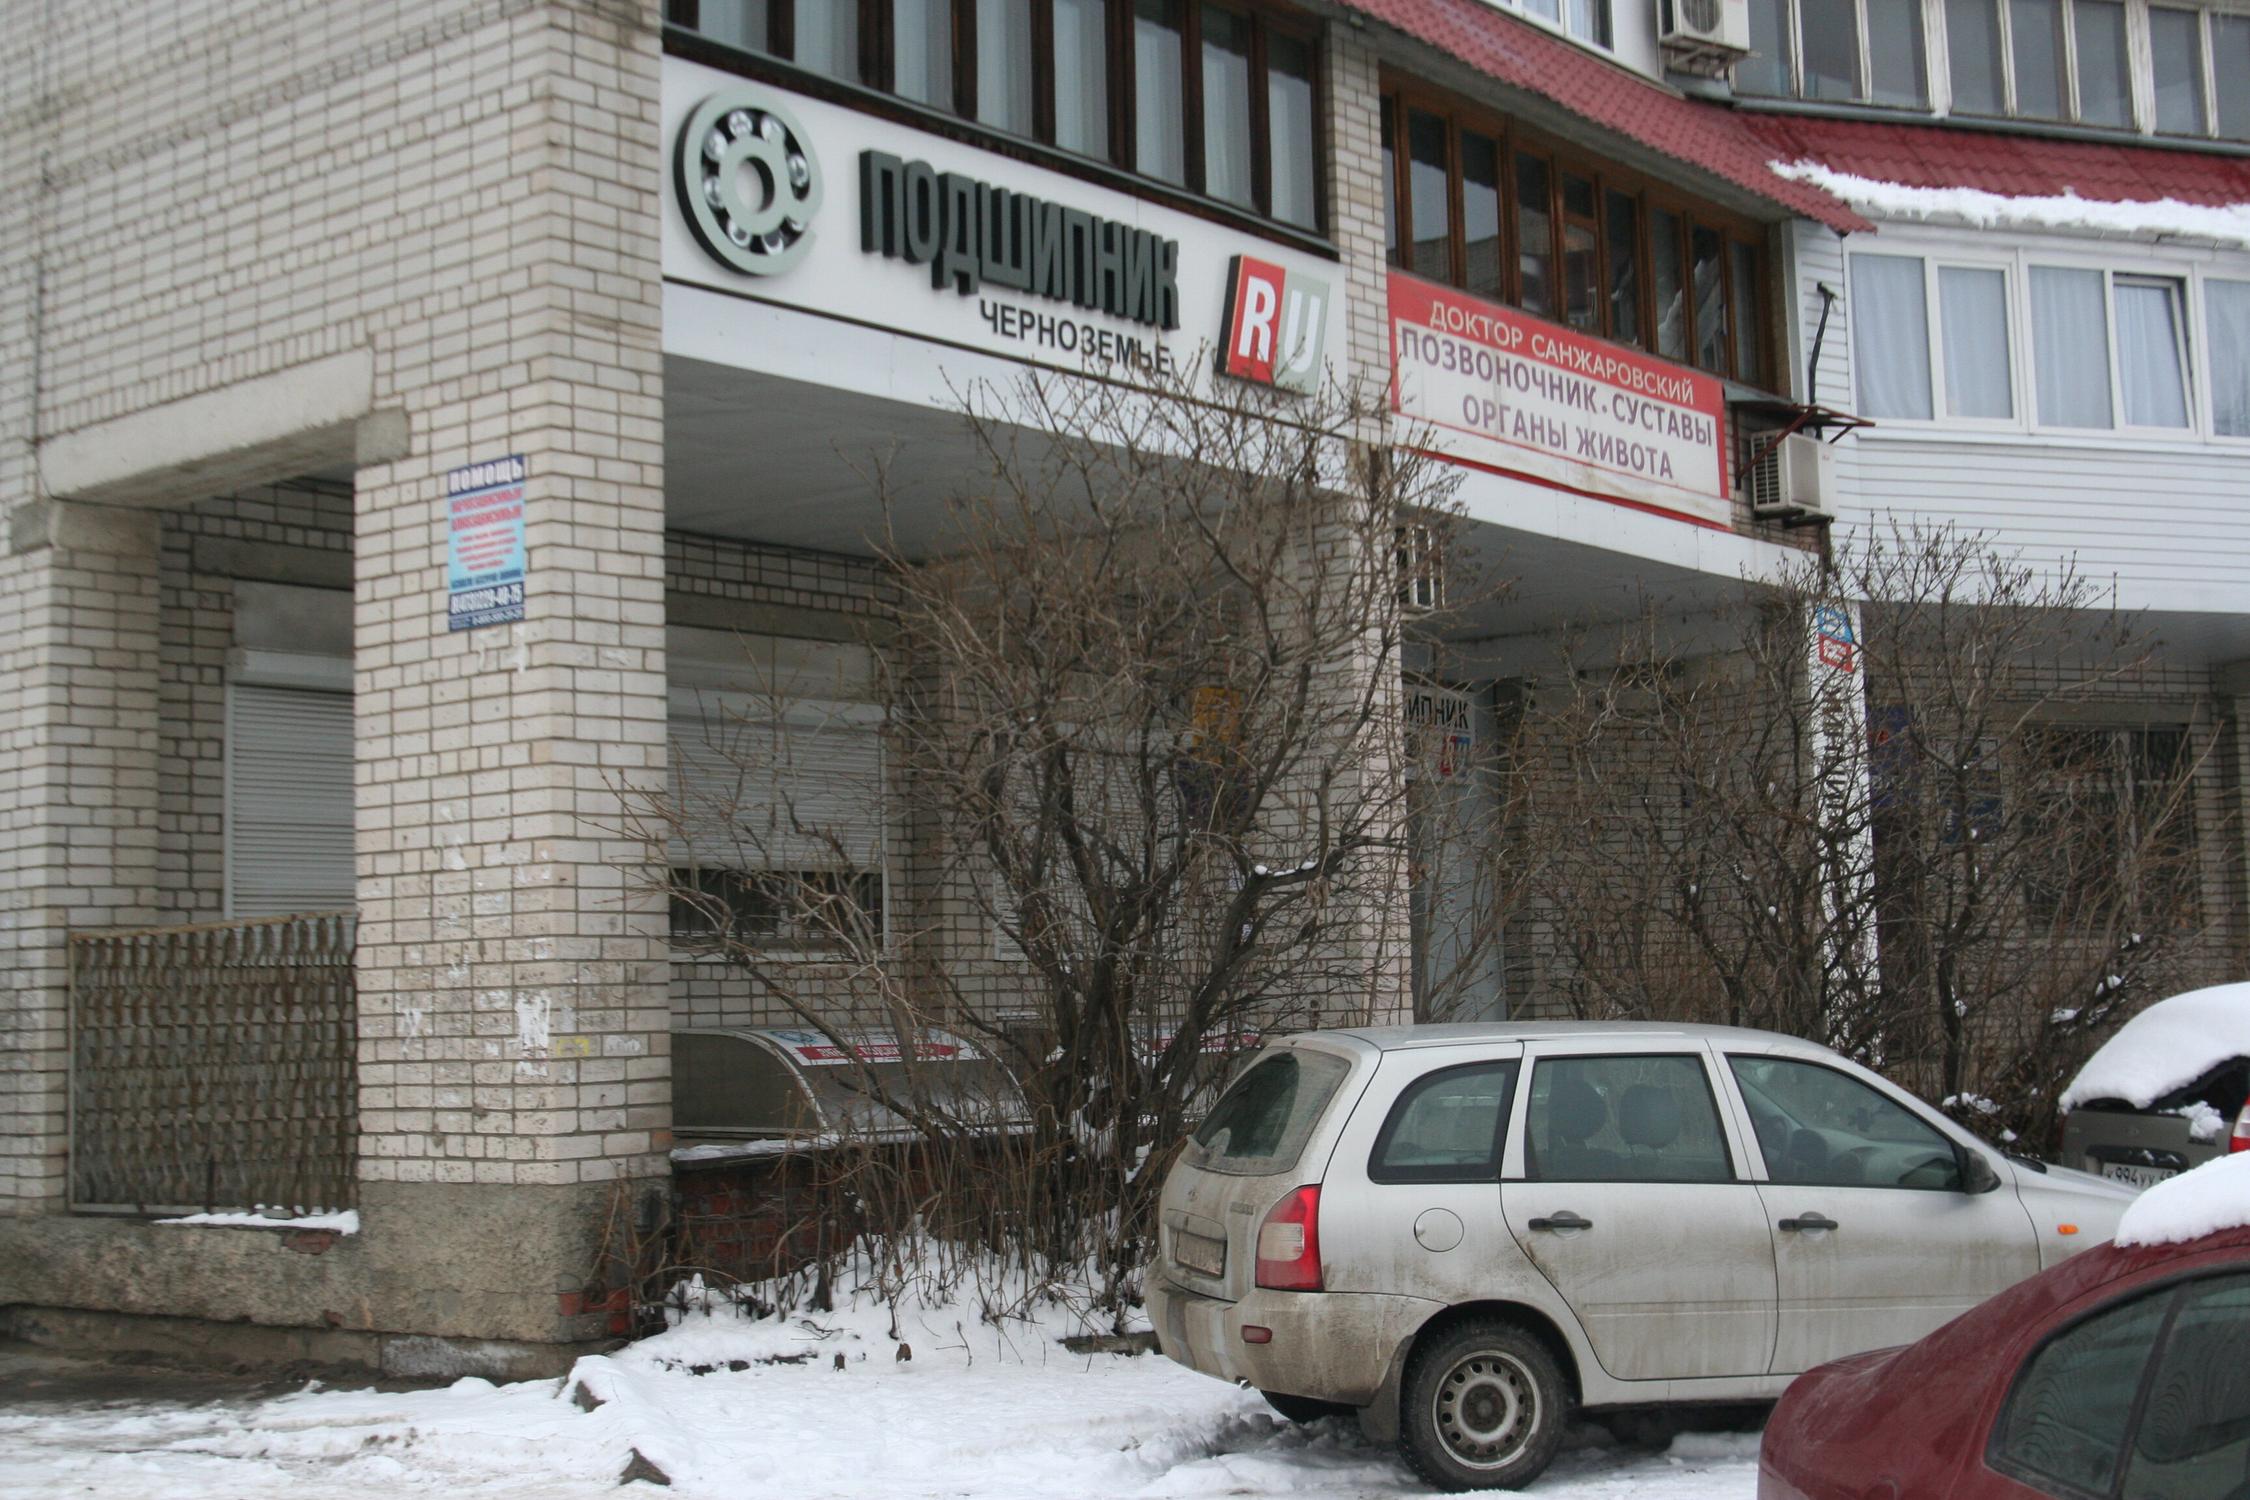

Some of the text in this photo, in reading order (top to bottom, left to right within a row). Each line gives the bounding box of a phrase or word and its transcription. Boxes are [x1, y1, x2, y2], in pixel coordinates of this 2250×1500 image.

[860, 149, 1180, 330] ПОДШИПНИК
[979, 298, 1171, 376] ЧЕРНОЗЕМЬЕ
[1238, 274, 1322, 373] RU
[1429, 301, 1694, 405] ДОКТОР САНЖАРОВСКИЙ
[1463, 395, 1673, 479] ОРГАНЫ ЖИВОТА
